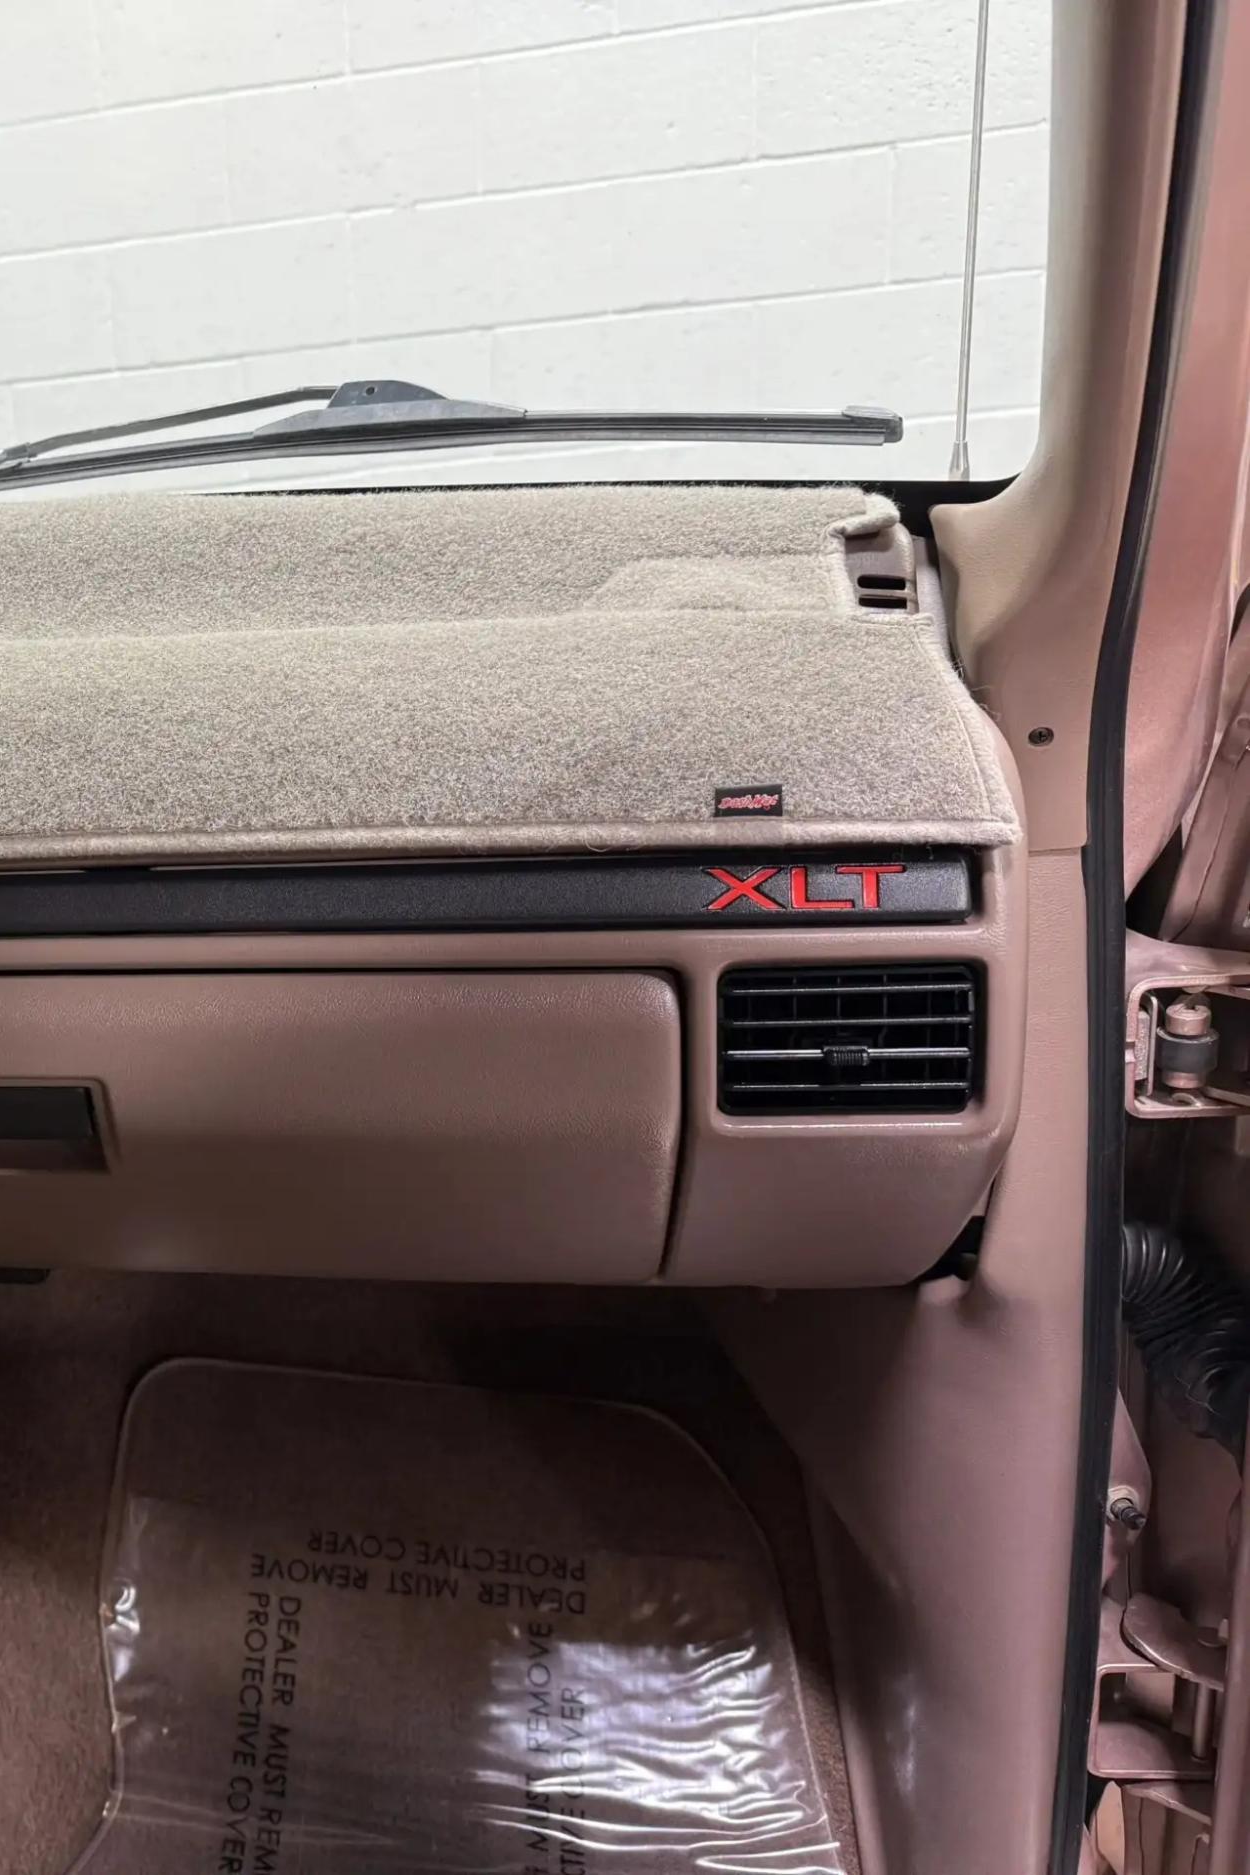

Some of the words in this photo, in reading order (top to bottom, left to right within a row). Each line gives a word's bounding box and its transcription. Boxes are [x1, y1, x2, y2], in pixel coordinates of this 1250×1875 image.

[702, 864, 906, 911] XLT
[251, 1553, 369, 1591] REMOVE
[307, 1531, 405, 1561] COVER
[415, 1541, 586, 1582] PROTECTIVE
[386, 1571, 460, 1598] MUST
[477, 1582, 586, 1615] DEALER
[232, 1592, 271, 1767] PROTECTIVE
[272, 1596, 302, 1706] DEALER
[527, 1622, 551, 1754] REMOVE
[262, 1723, 291, 1798] MUST
[218, 1776, 253, 1874] COVER
[254, 1806, 283, 1875] REM
[525, 1773, 549, 1851] MUST
